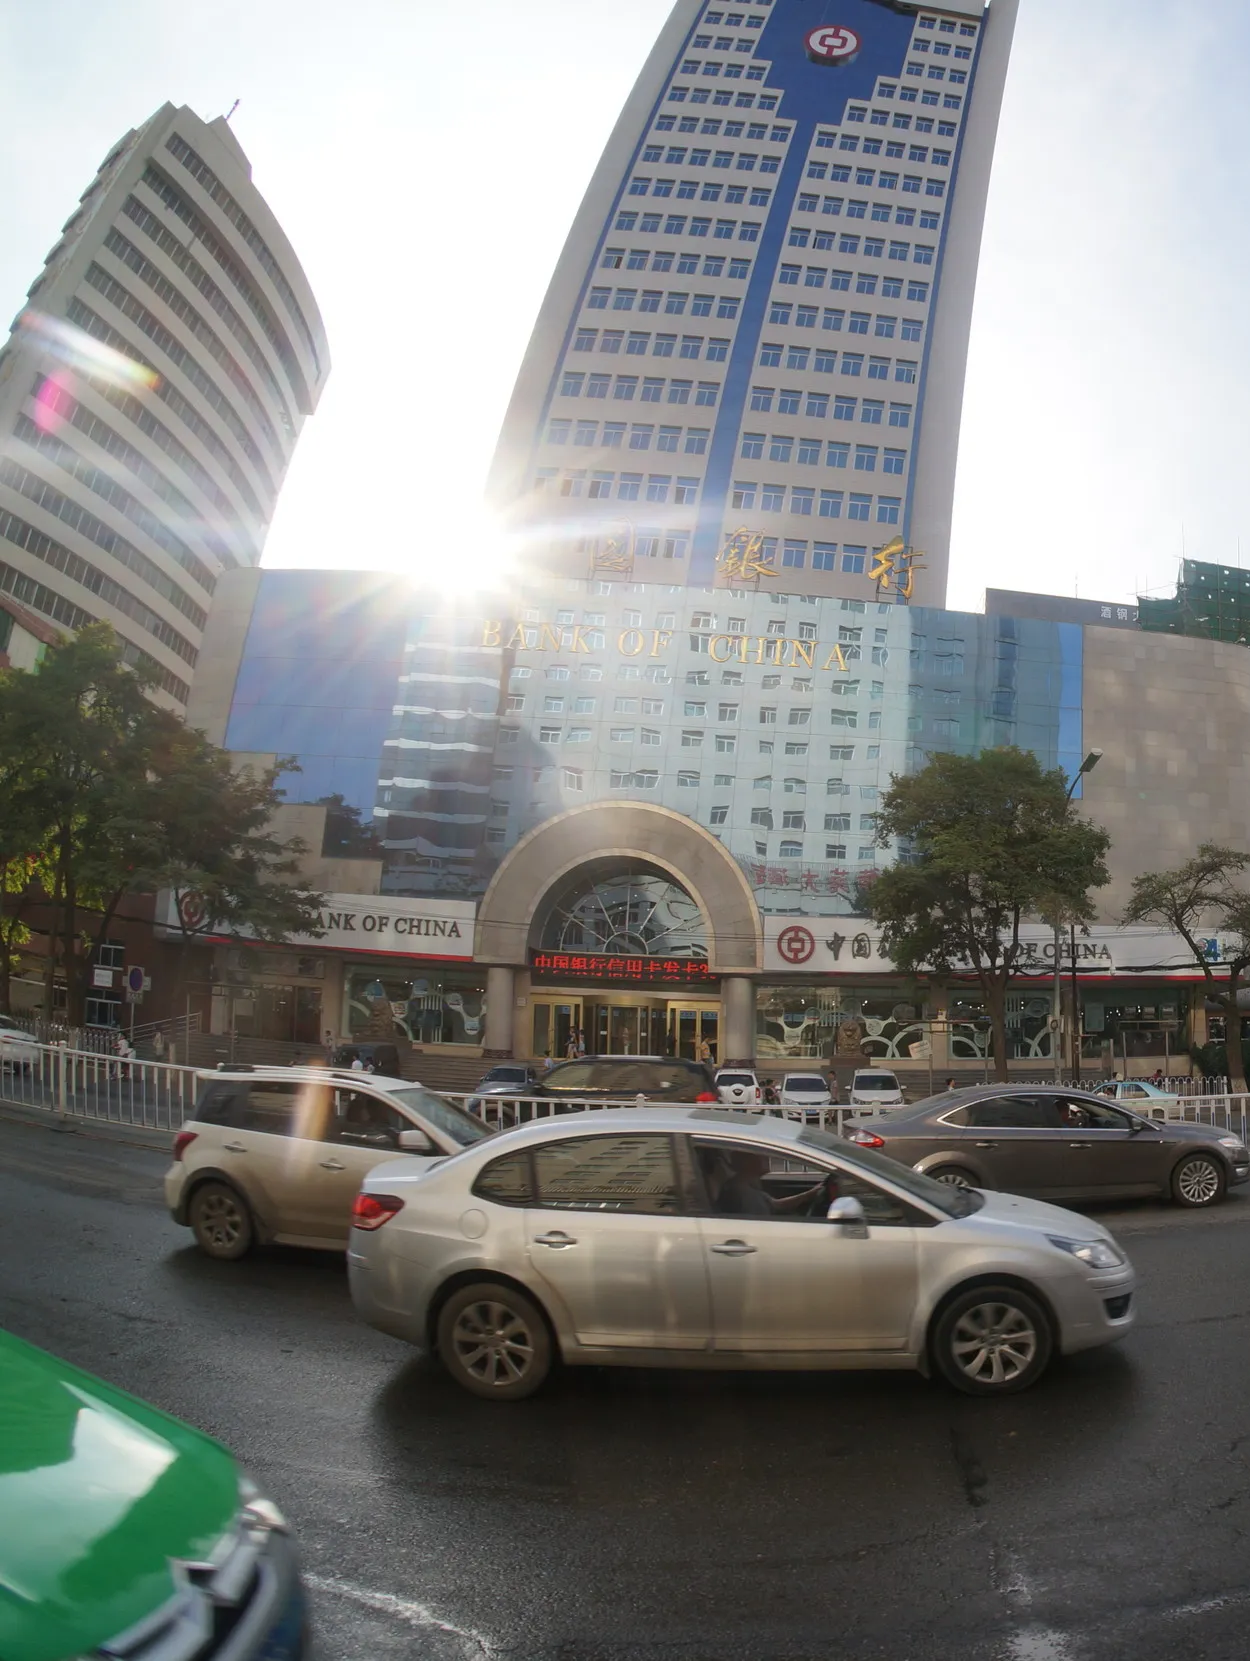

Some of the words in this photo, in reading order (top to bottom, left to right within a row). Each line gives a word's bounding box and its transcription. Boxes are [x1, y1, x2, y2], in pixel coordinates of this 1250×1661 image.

[482, 619, 593, 655] BANK
[617, 629, 674, 658] OF
[708, 634, 850, 673] CHINA
[362, 914, 390, 933] OF
[394, 917, 462, 938] CHINA
[1043, 942, 1112, 960] CHINA
